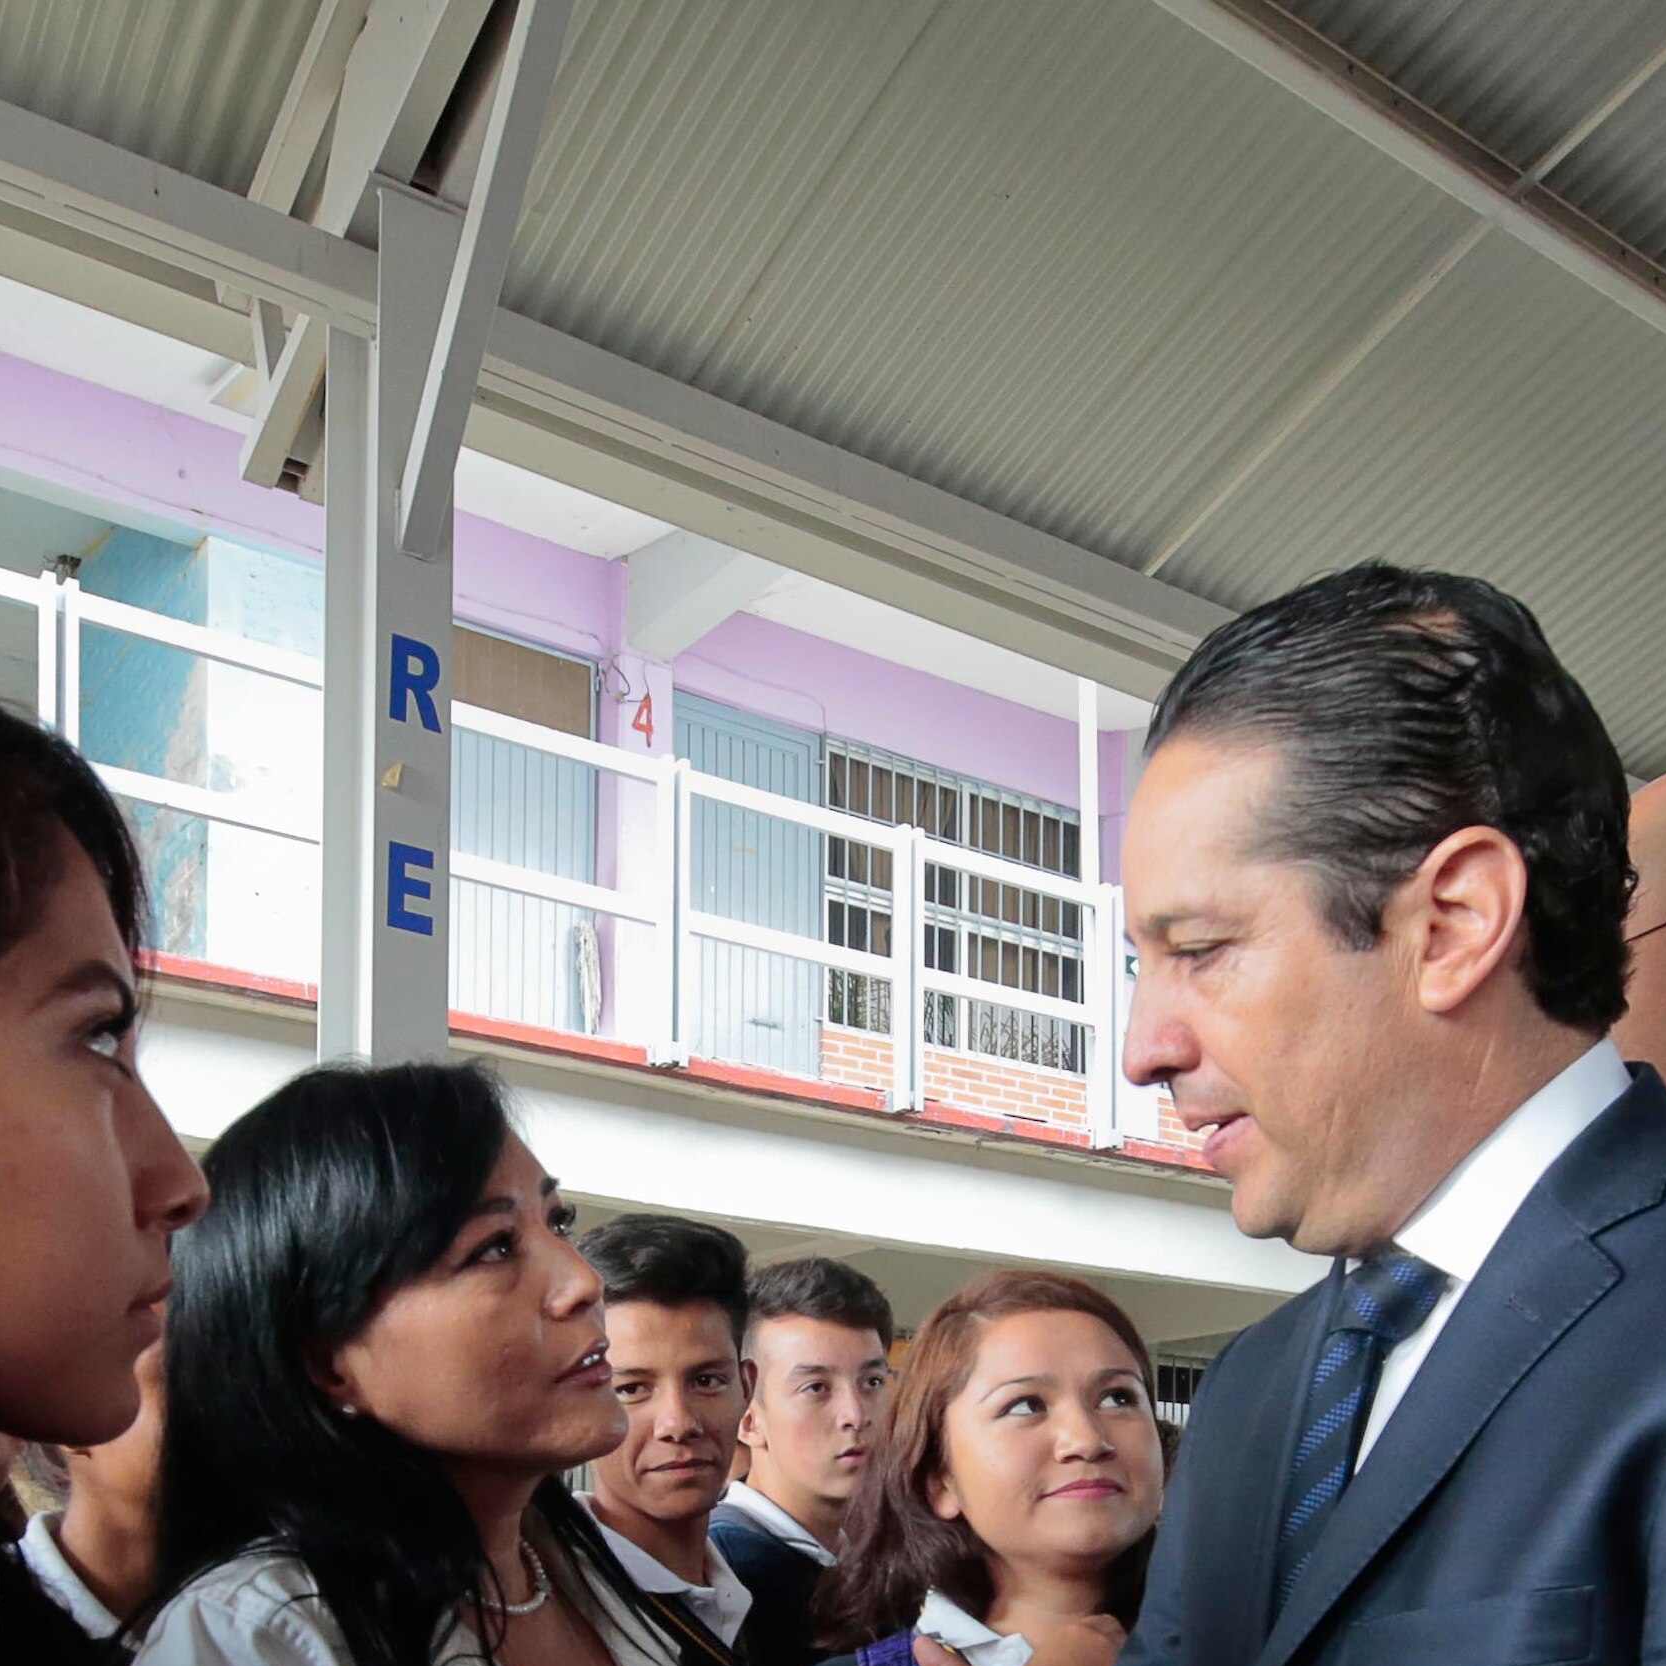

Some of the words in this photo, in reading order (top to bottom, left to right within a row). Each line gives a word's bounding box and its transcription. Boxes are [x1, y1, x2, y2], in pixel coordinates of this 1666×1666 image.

[389, 633, 442, 734] R
[632, 693, 653, 748] 4
[386, 840, 434, 936] E
